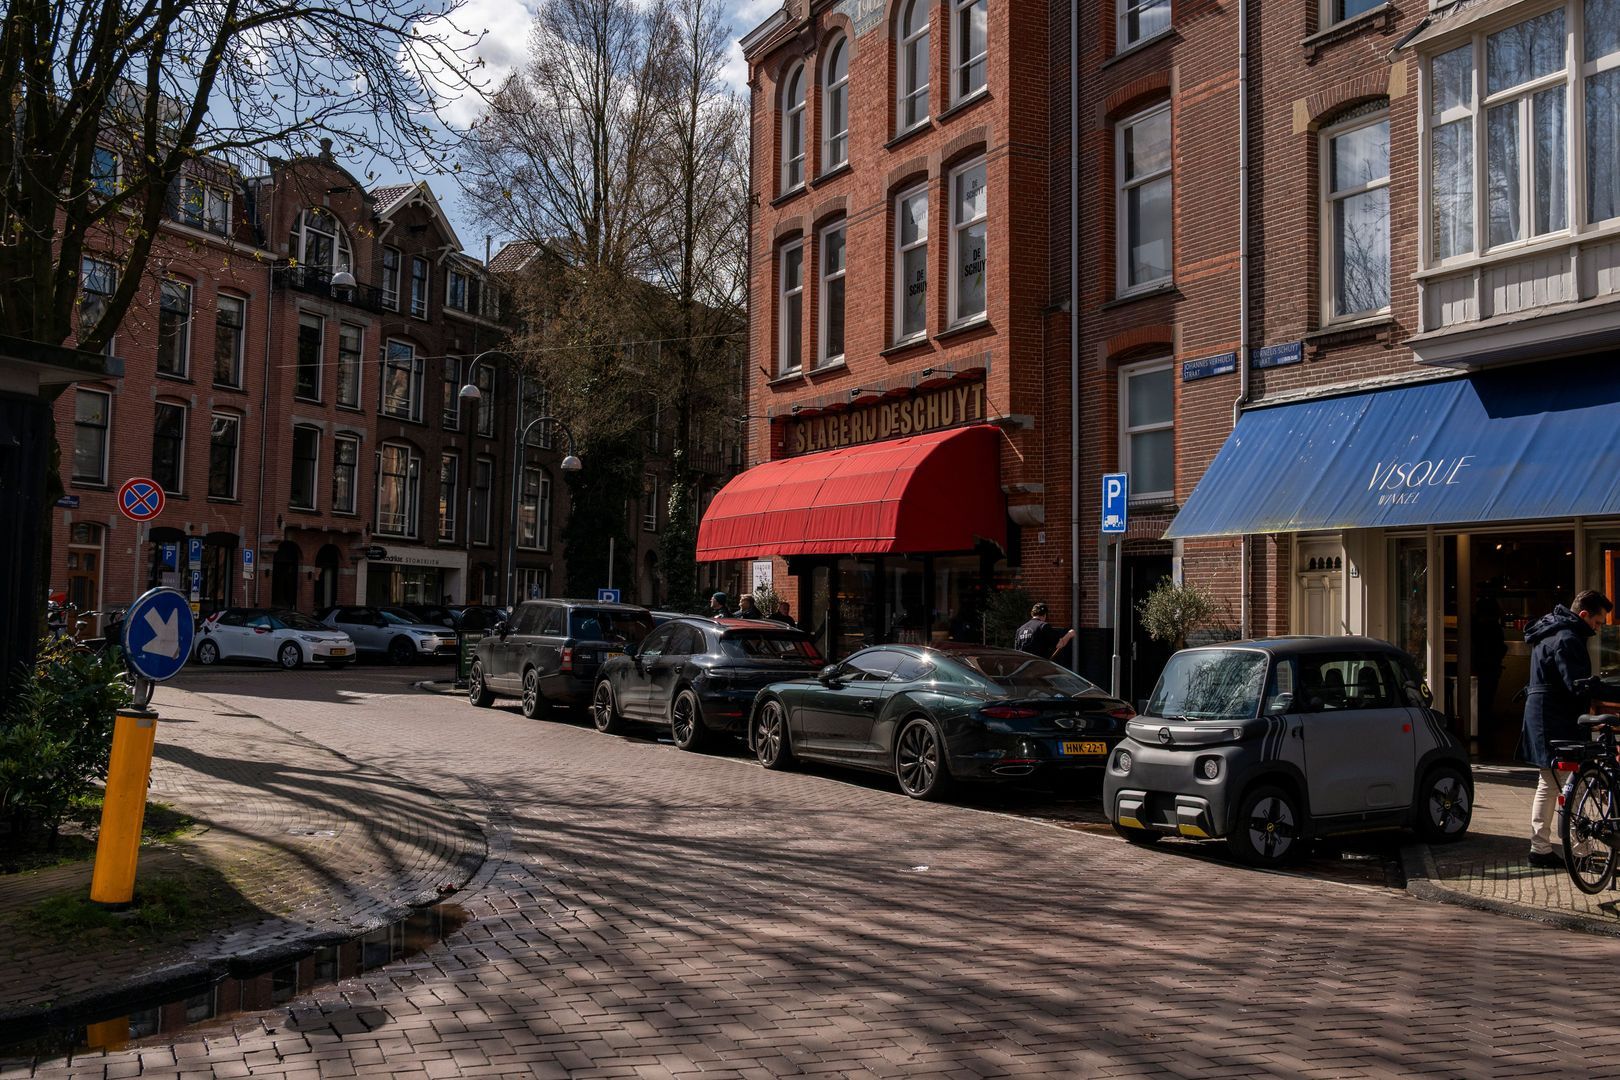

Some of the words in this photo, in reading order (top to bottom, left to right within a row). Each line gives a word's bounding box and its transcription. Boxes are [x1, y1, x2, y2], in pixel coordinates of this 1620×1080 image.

[973, 249, 980, 260] DE
[965, 260, 985, 276] SCHUY
[916, 270, 924, 282] DE
[909, 282, 927, 296] SCHUY
[1278, 344, 1298, 354] SCHUYT
[1184, 369, 1200, 379] STRAAT
[795, 406, 877, 453] SLAGERIJ
[900, 383, 984, 434] SCHUYT
[1367, 455, 1476, 492] VISQUE
[1108, 479, 1122, 508] P
[1378, 492, 1420, 506] WINKEL
[192, 540, 200, 553] P
[166, 551, 173, 560] P
[246, 551, 251, 562] P
[1066, 743, 1104, 753] HNK-22-T
